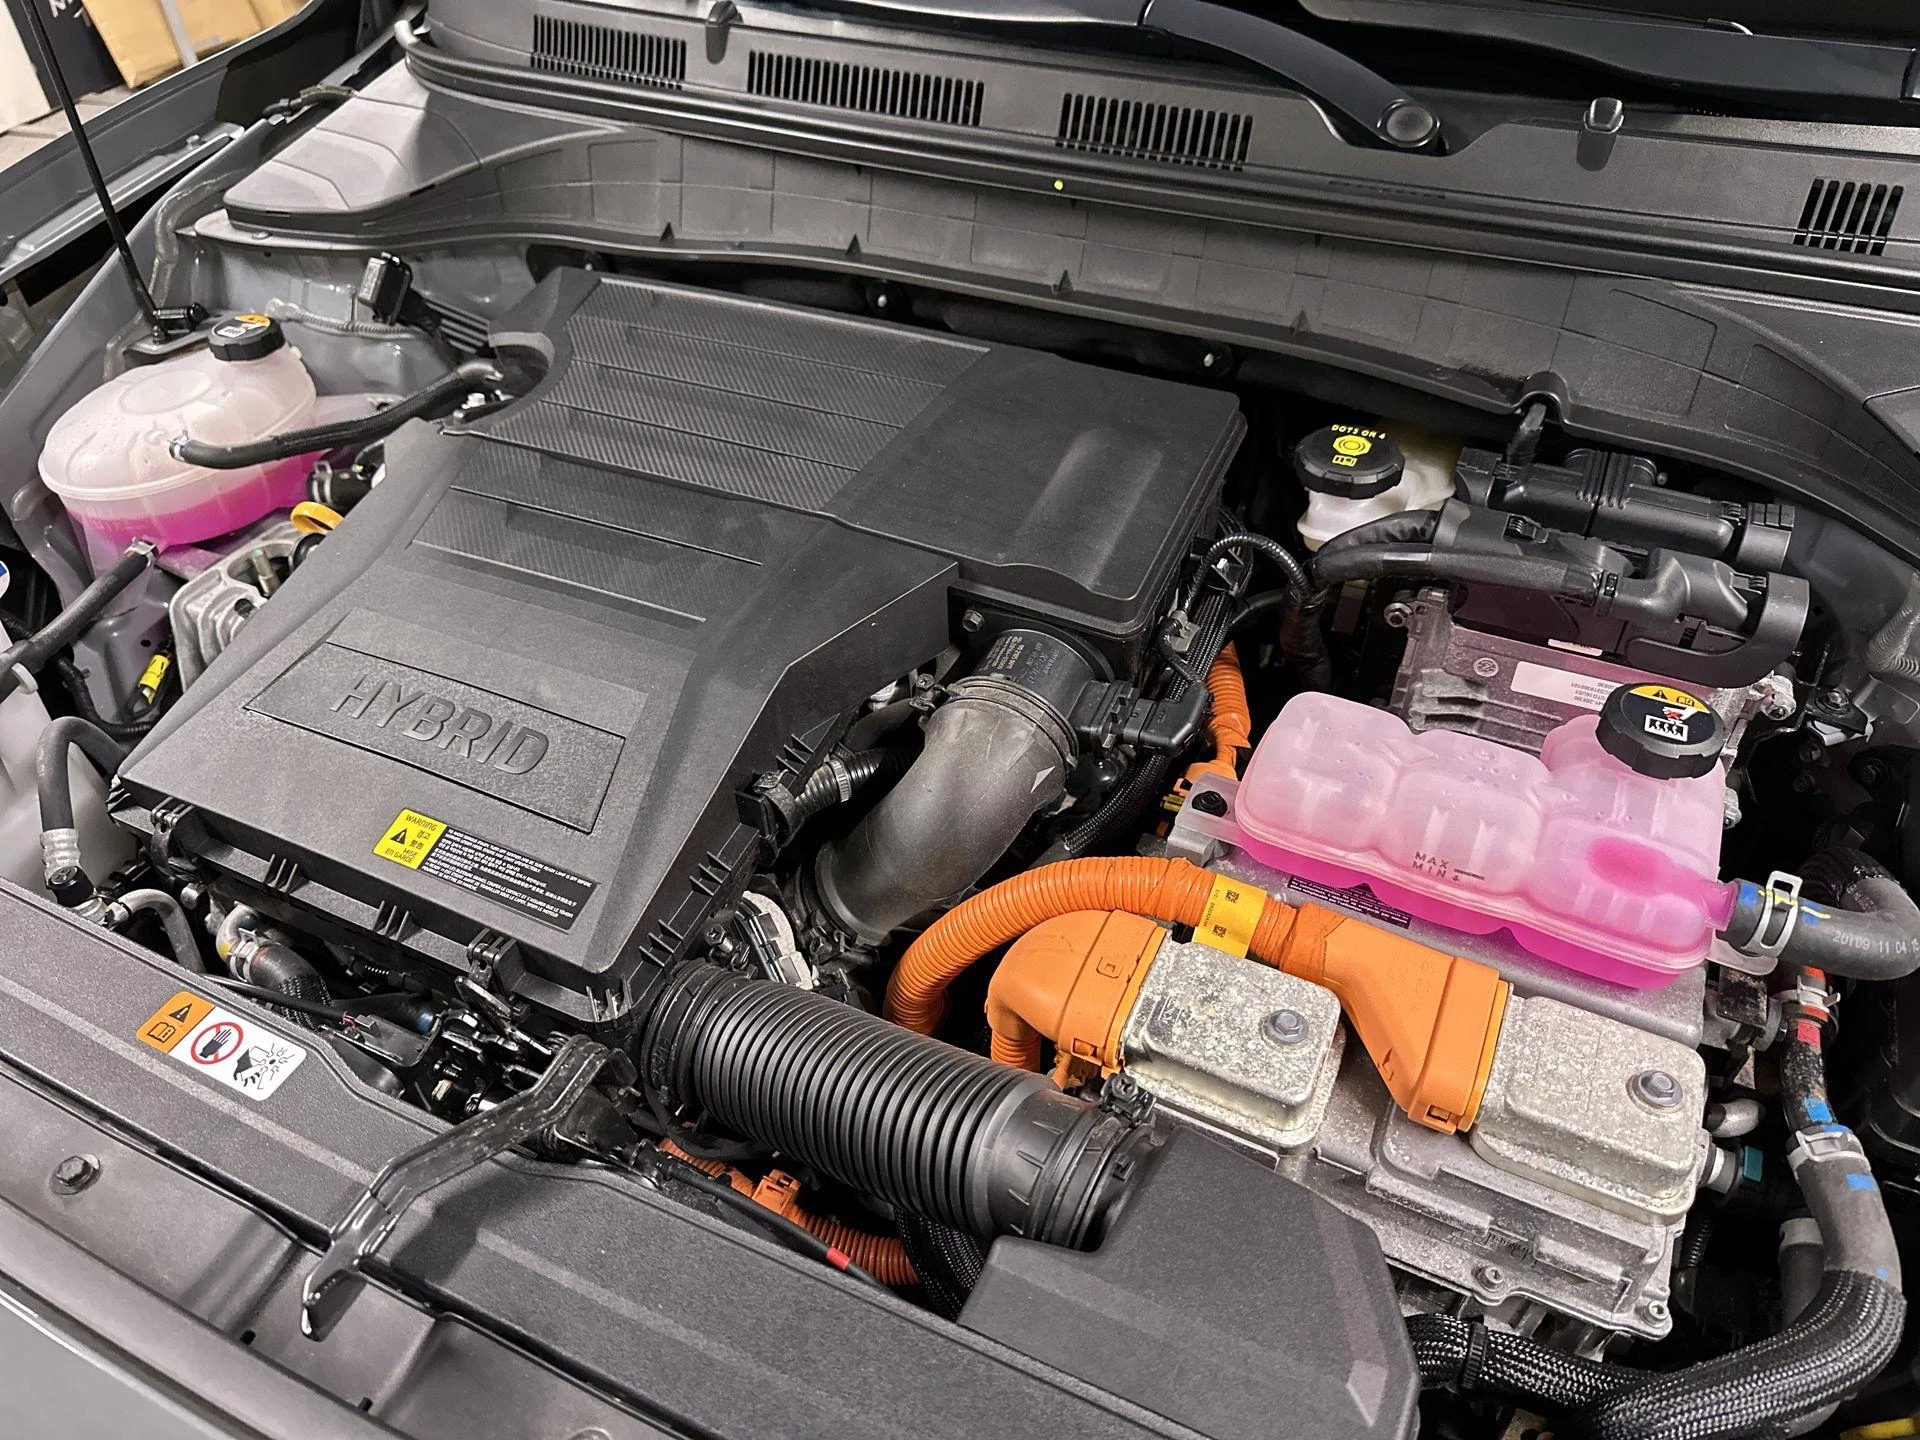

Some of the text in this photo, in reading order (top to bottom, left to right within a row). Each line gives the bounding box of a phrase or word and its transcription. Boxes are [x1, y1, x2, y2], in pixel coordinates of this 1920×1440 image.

[1361, 430, 1377, 438] OR
[330, 674, 549, 774] HYBRID
[406, 815, 438, 831] WARNING
[417, 830, 430, 839] 경고
[385, 848, 414, 863] EN GARDE
[402, 848, 418, 858] MISE
[1414, 851, 1448, 869] MAX
[1412, 860, 1446, 878] MIN
